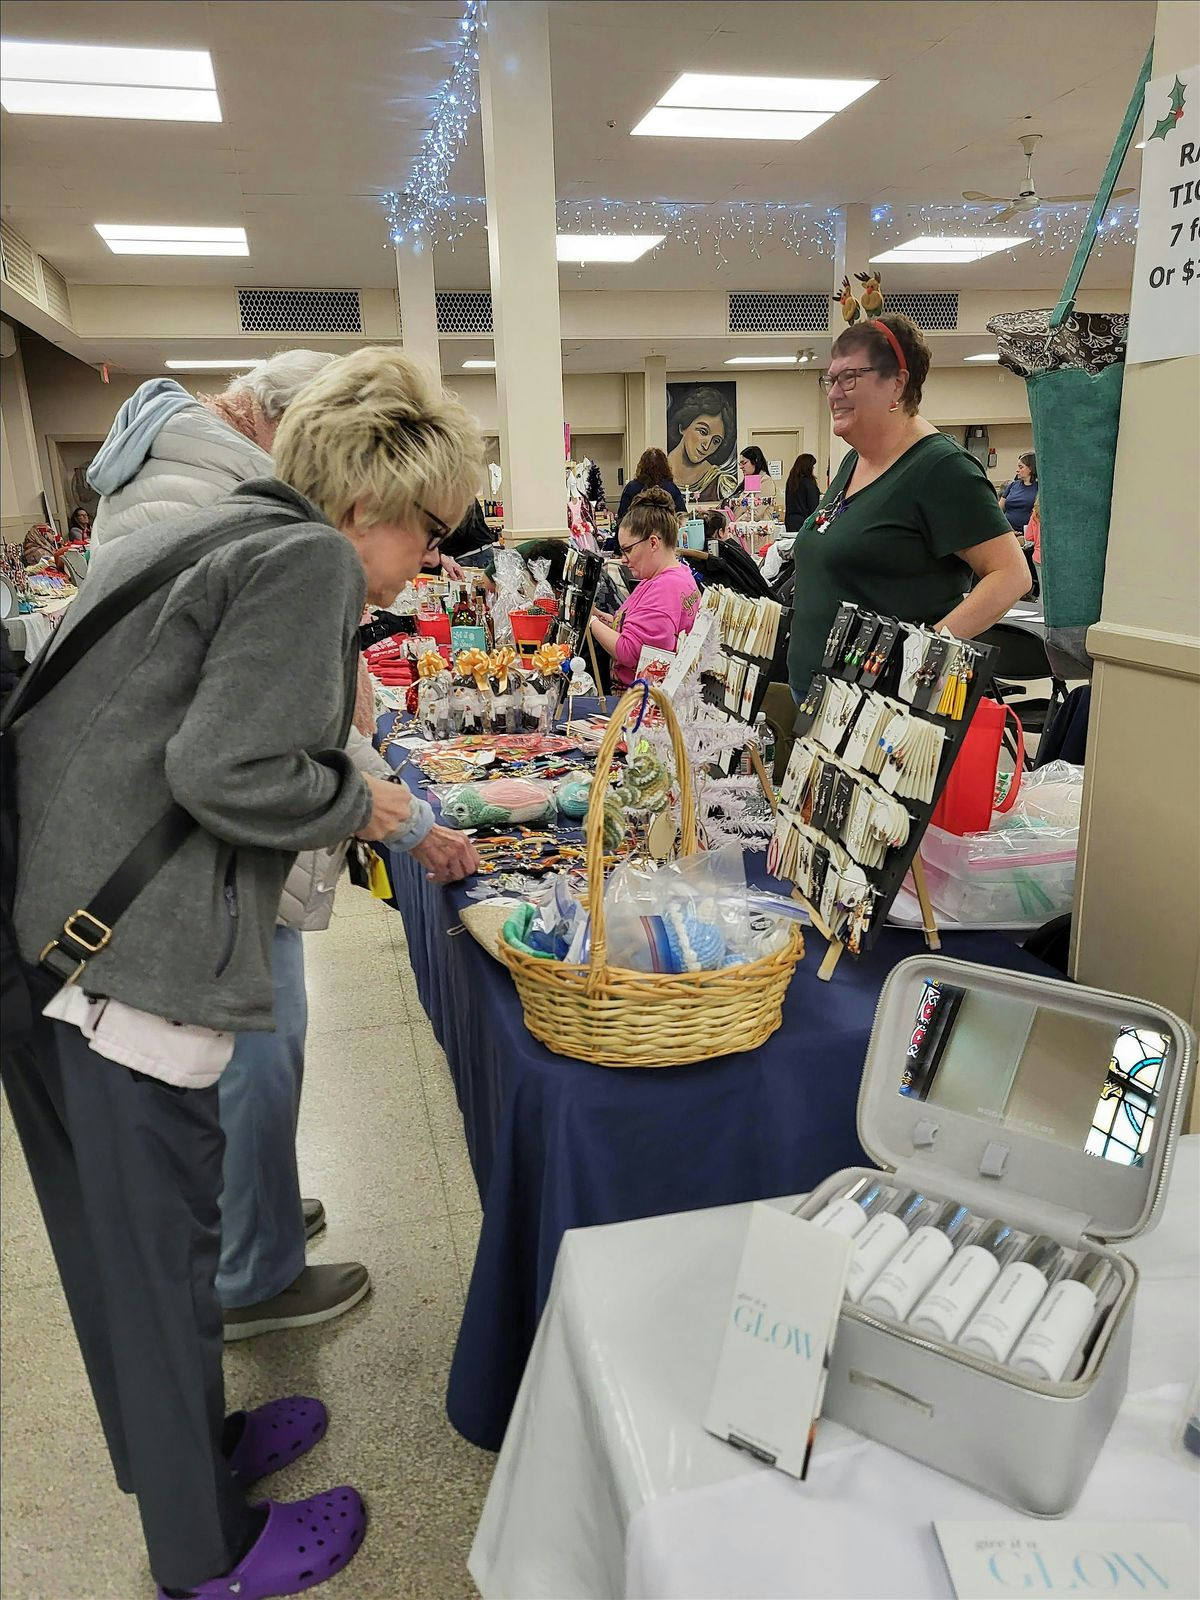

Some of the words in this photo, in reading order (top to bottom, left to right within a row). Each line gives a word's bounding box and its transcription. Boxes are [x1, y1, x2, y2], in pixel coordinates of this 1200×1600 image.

[1170, 223, 1183, 247] 7
[1190, 216, 1200, 241] f
[1149, 266, 1175, 289] Or
[733, 1305, 812, 1359] GLOW
[988, 1552, 1169, 1590] GLOW
